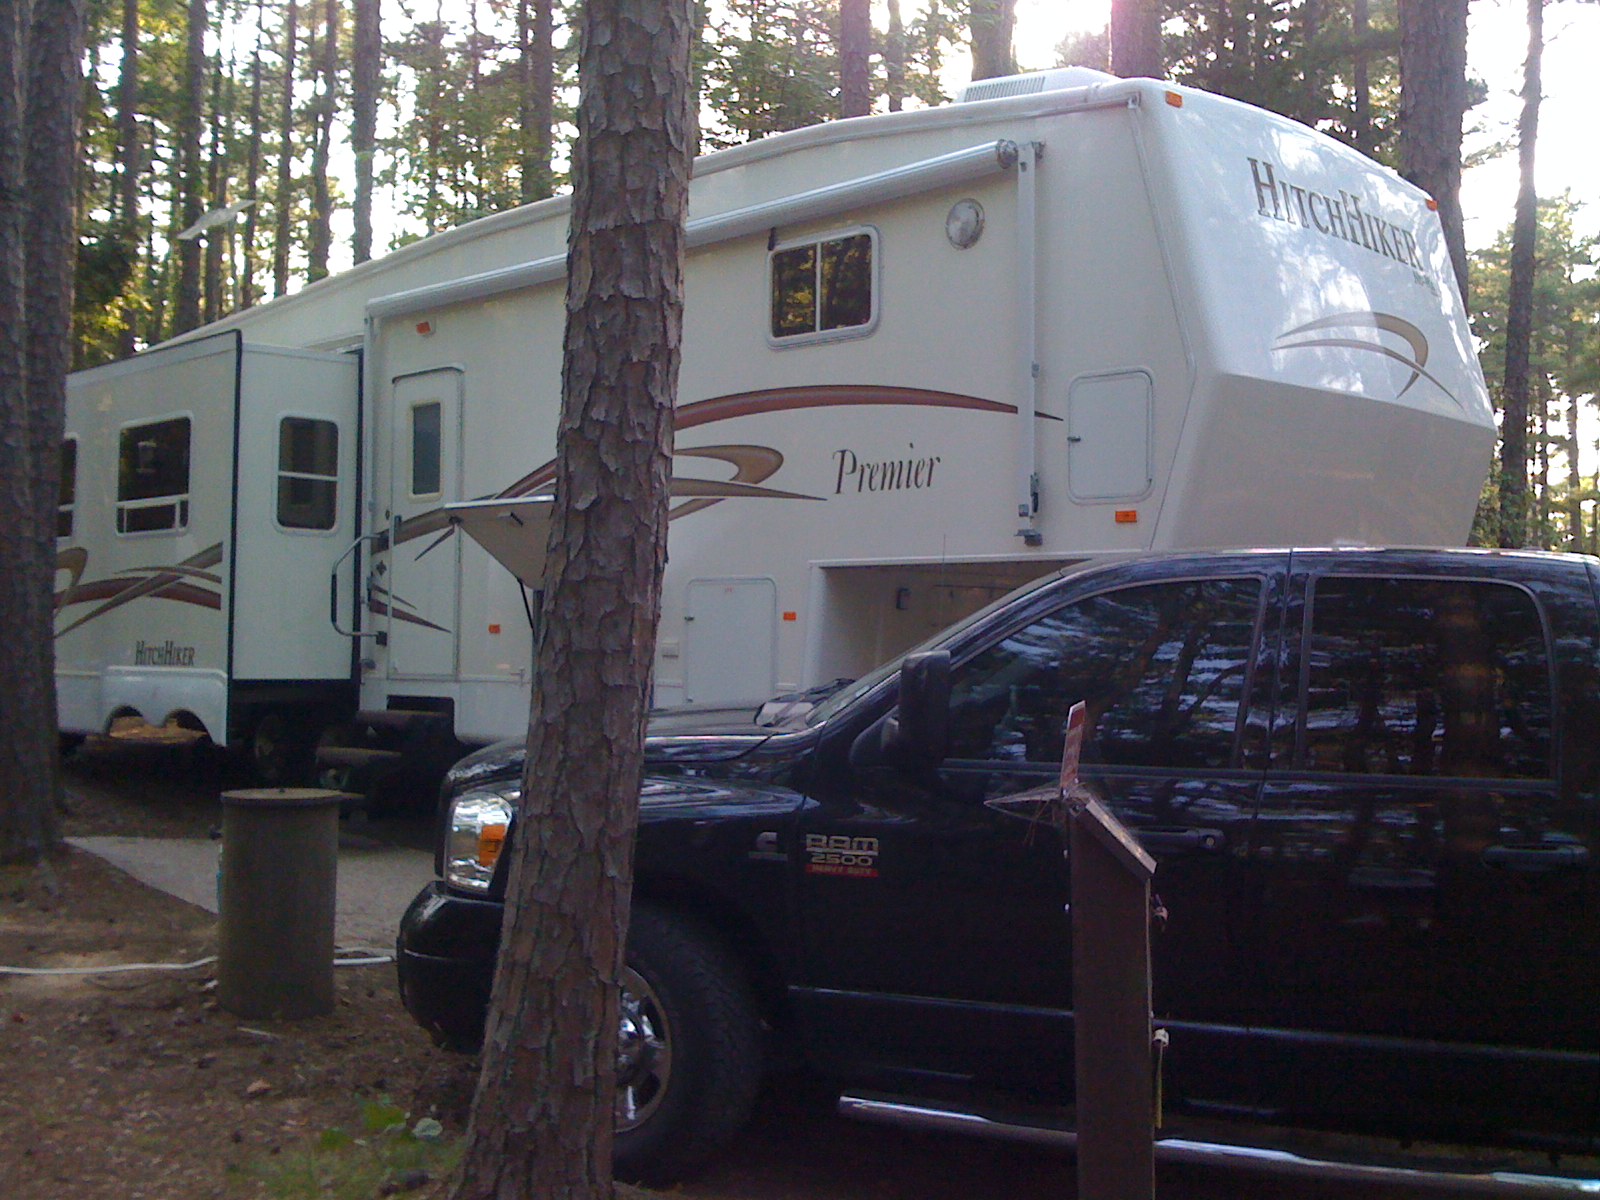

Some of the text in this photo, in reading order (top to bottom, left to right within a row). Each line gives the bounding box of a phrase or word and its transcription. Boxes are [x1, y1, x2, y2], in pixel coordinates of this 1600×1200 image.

[832, 442, 941, 494] Premier
[806, 833, 879, 856] RAM
[811, 852, 873, 866] 2500
